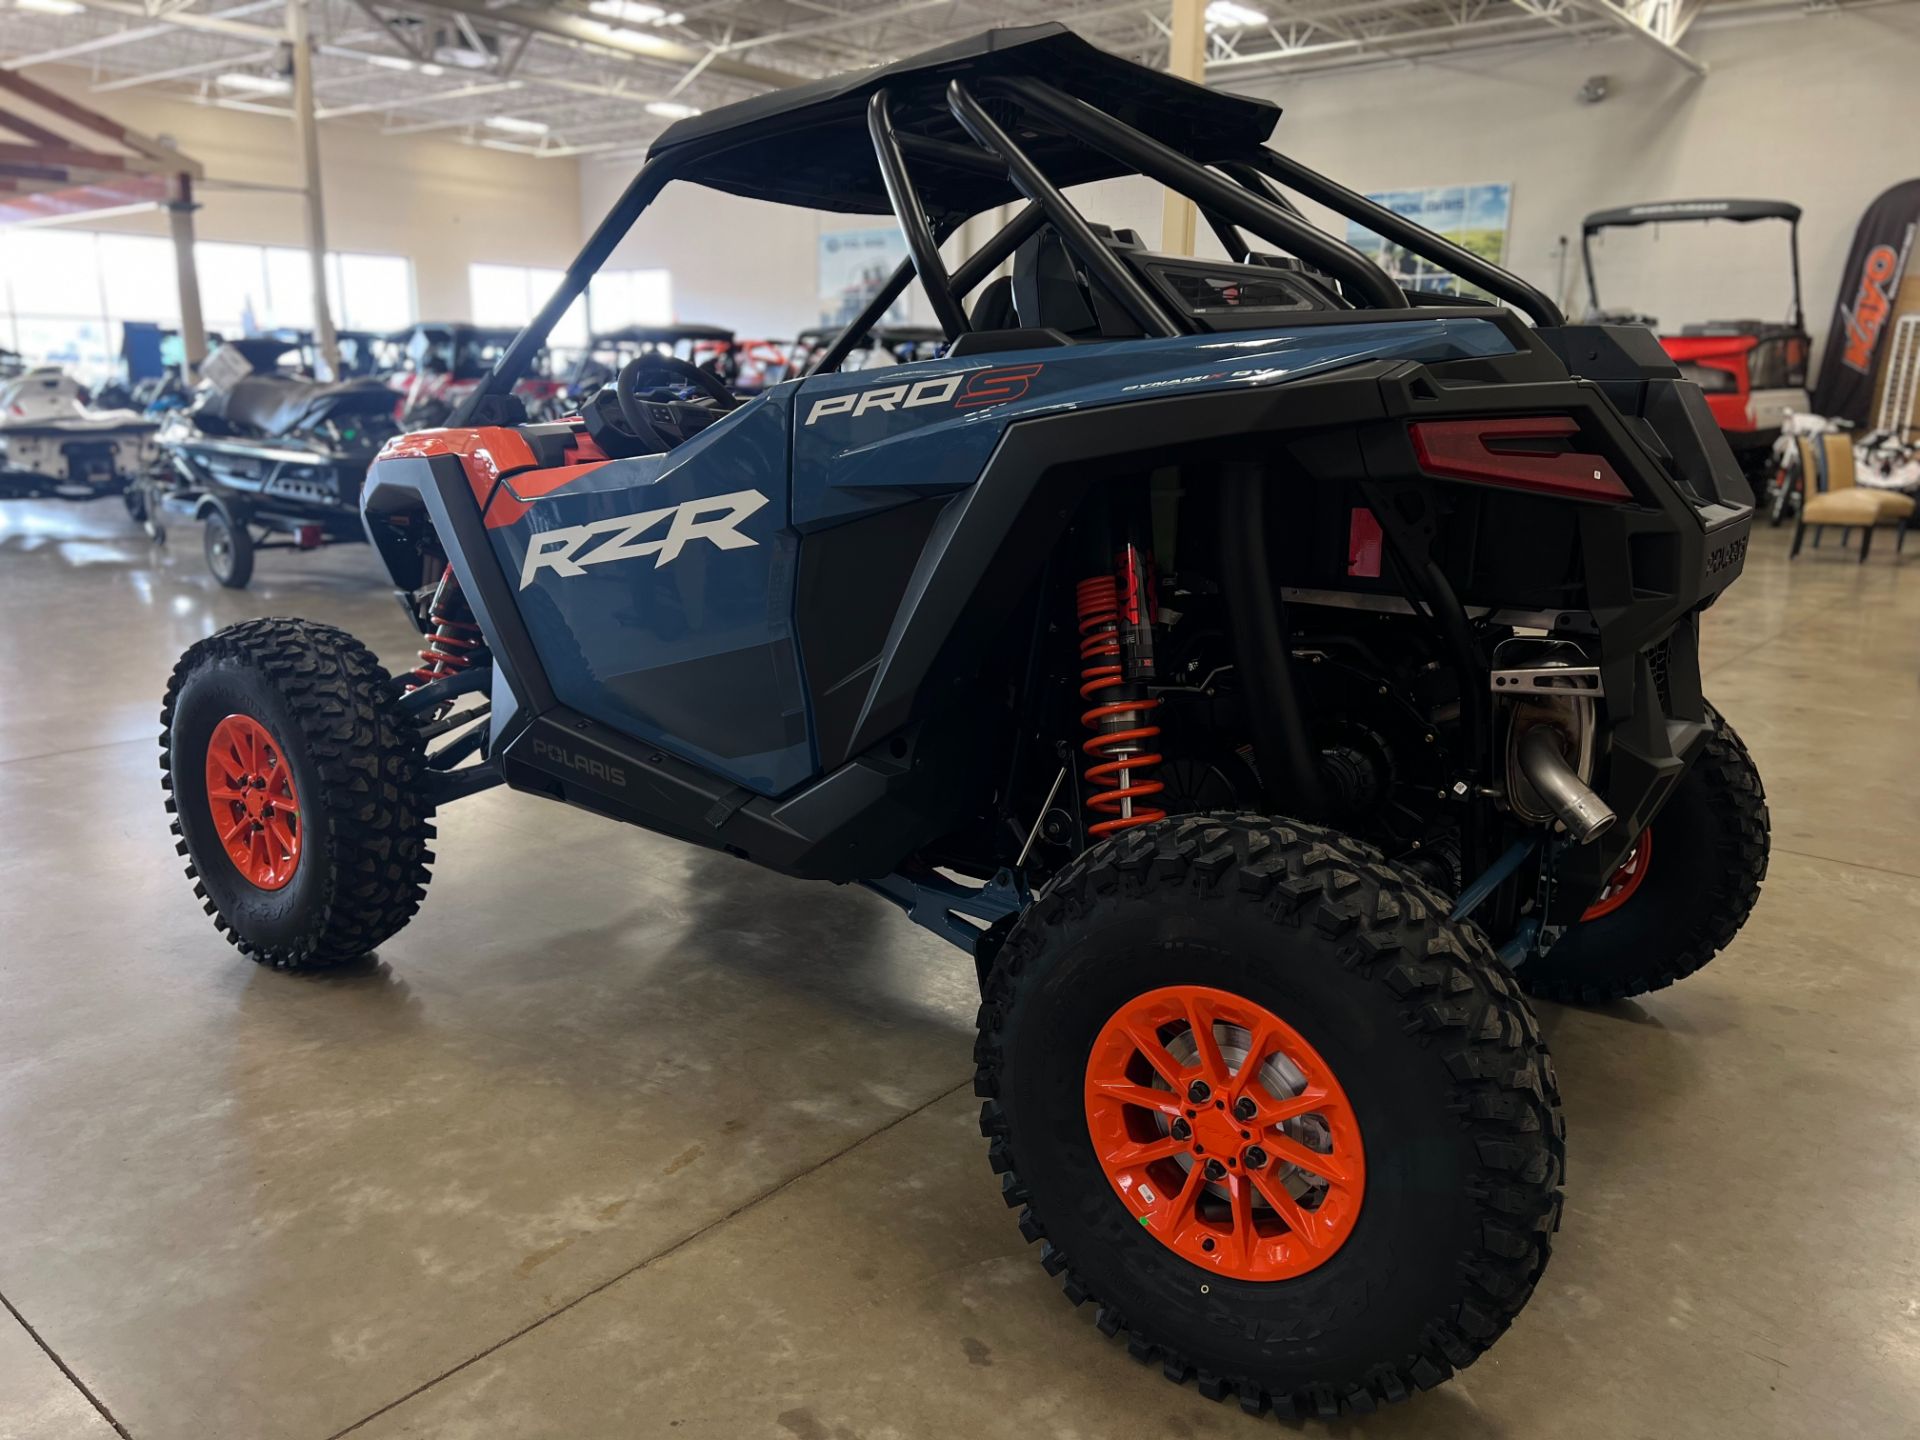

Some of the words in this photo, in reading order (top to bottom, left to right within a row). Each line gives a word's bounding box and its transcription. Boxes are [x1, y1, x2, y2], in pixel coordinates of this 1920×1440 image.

[804, 374, 964, 426] PRO
[955, 363, 1044, 409] S
[519, 488, 771, 592] RZR
[532, 737, 627, 787] POLARIS
